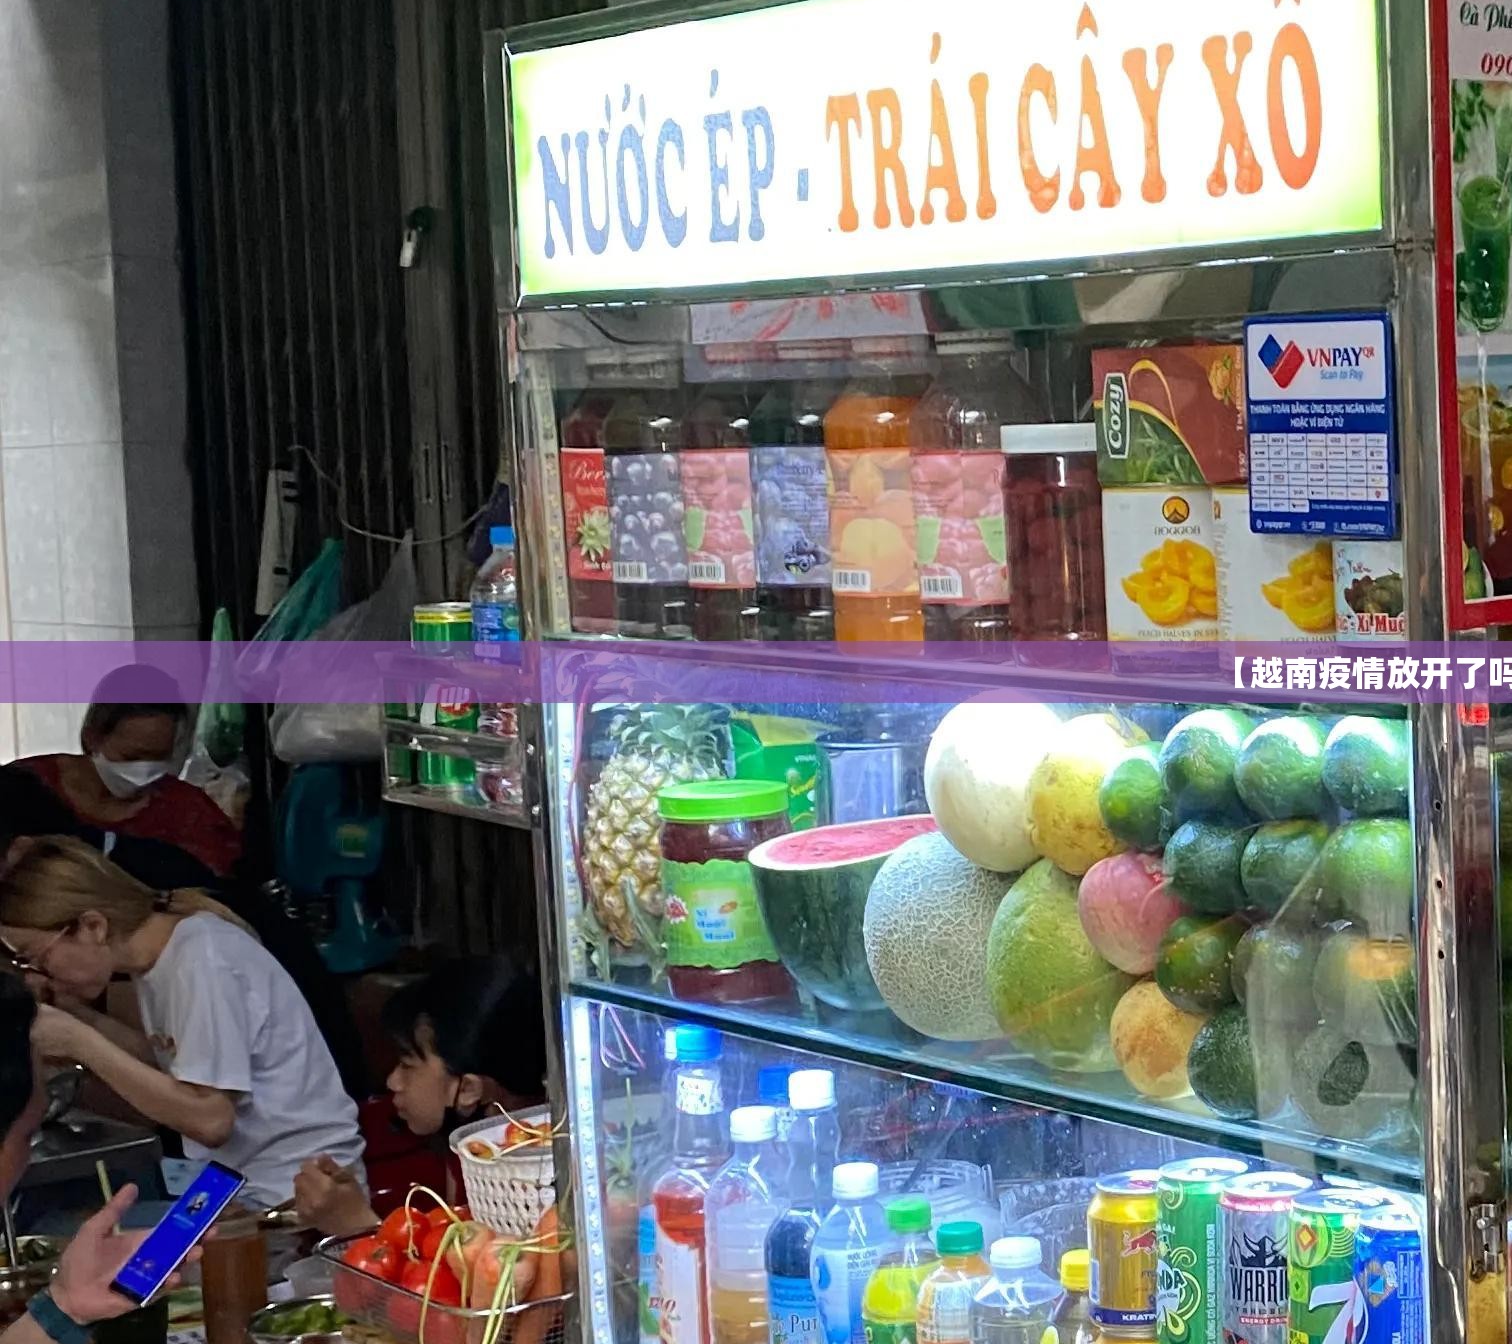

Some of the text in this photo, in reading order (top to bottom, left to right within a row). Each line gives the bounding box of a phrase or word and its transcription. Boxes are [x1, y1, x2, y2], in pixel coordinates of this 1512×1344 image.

[537, 82, 688, 260] NƯỚC
[703, 69, 776, 244] ÉP
[825, 31, 999, 234] TRÁI
[1017, 1, 1176, 216] CÂY
[1231, 1267, 1288, 1307] WARRI
